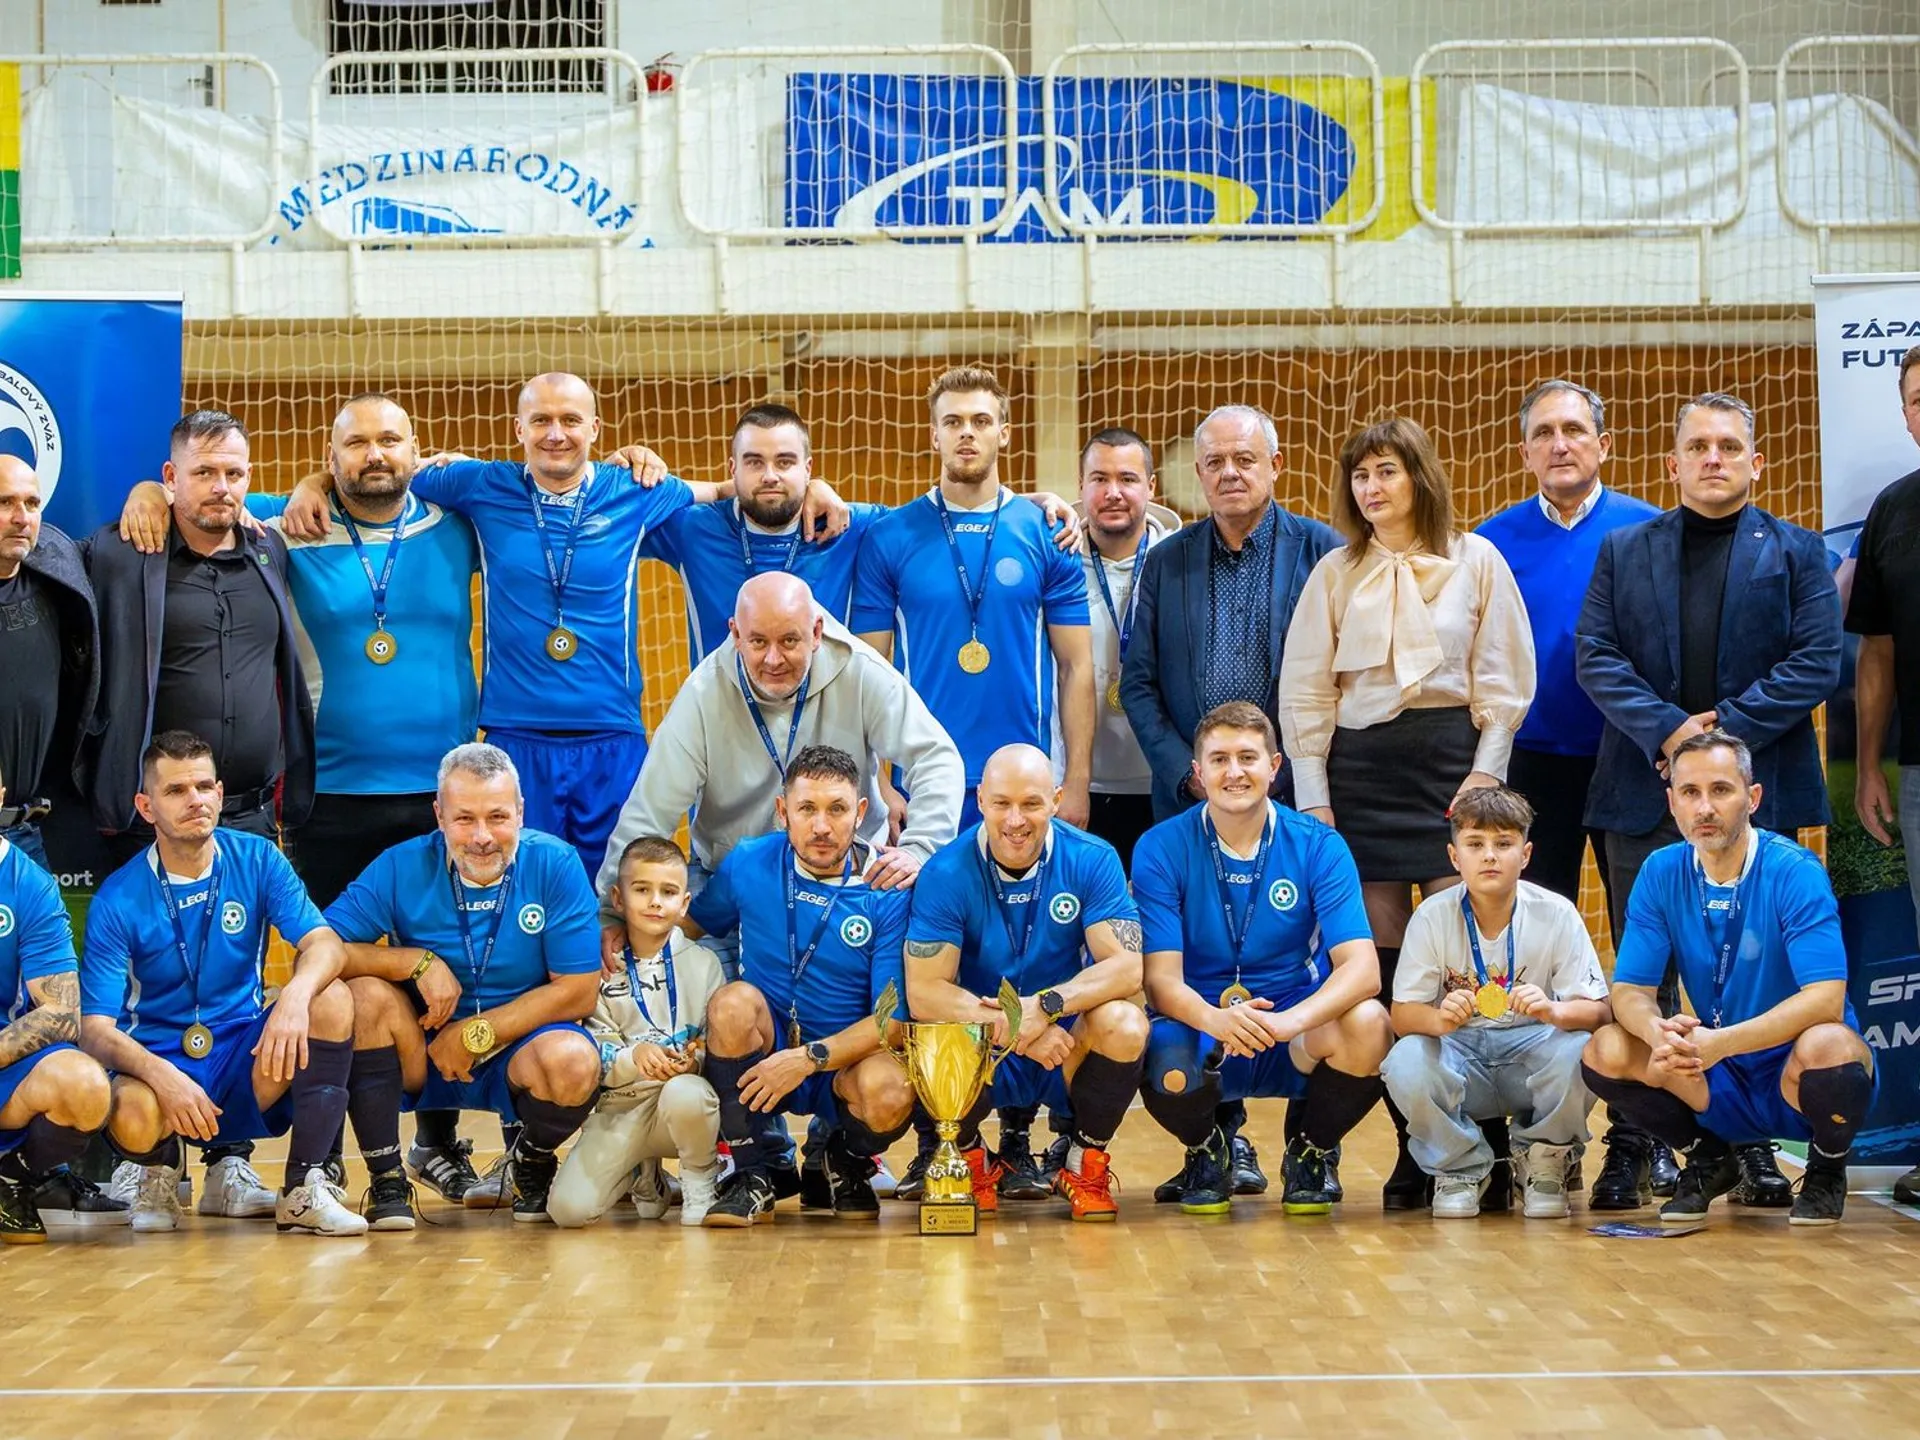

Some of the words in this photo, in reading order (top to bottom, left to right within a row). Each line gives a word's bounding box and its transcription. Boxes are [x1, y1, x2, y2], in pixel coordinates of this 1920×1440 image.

[946, 186, 1143, 237] TAM
[541, 494, 578, 508] LEGE
[52, 870, 94, 887] ort
